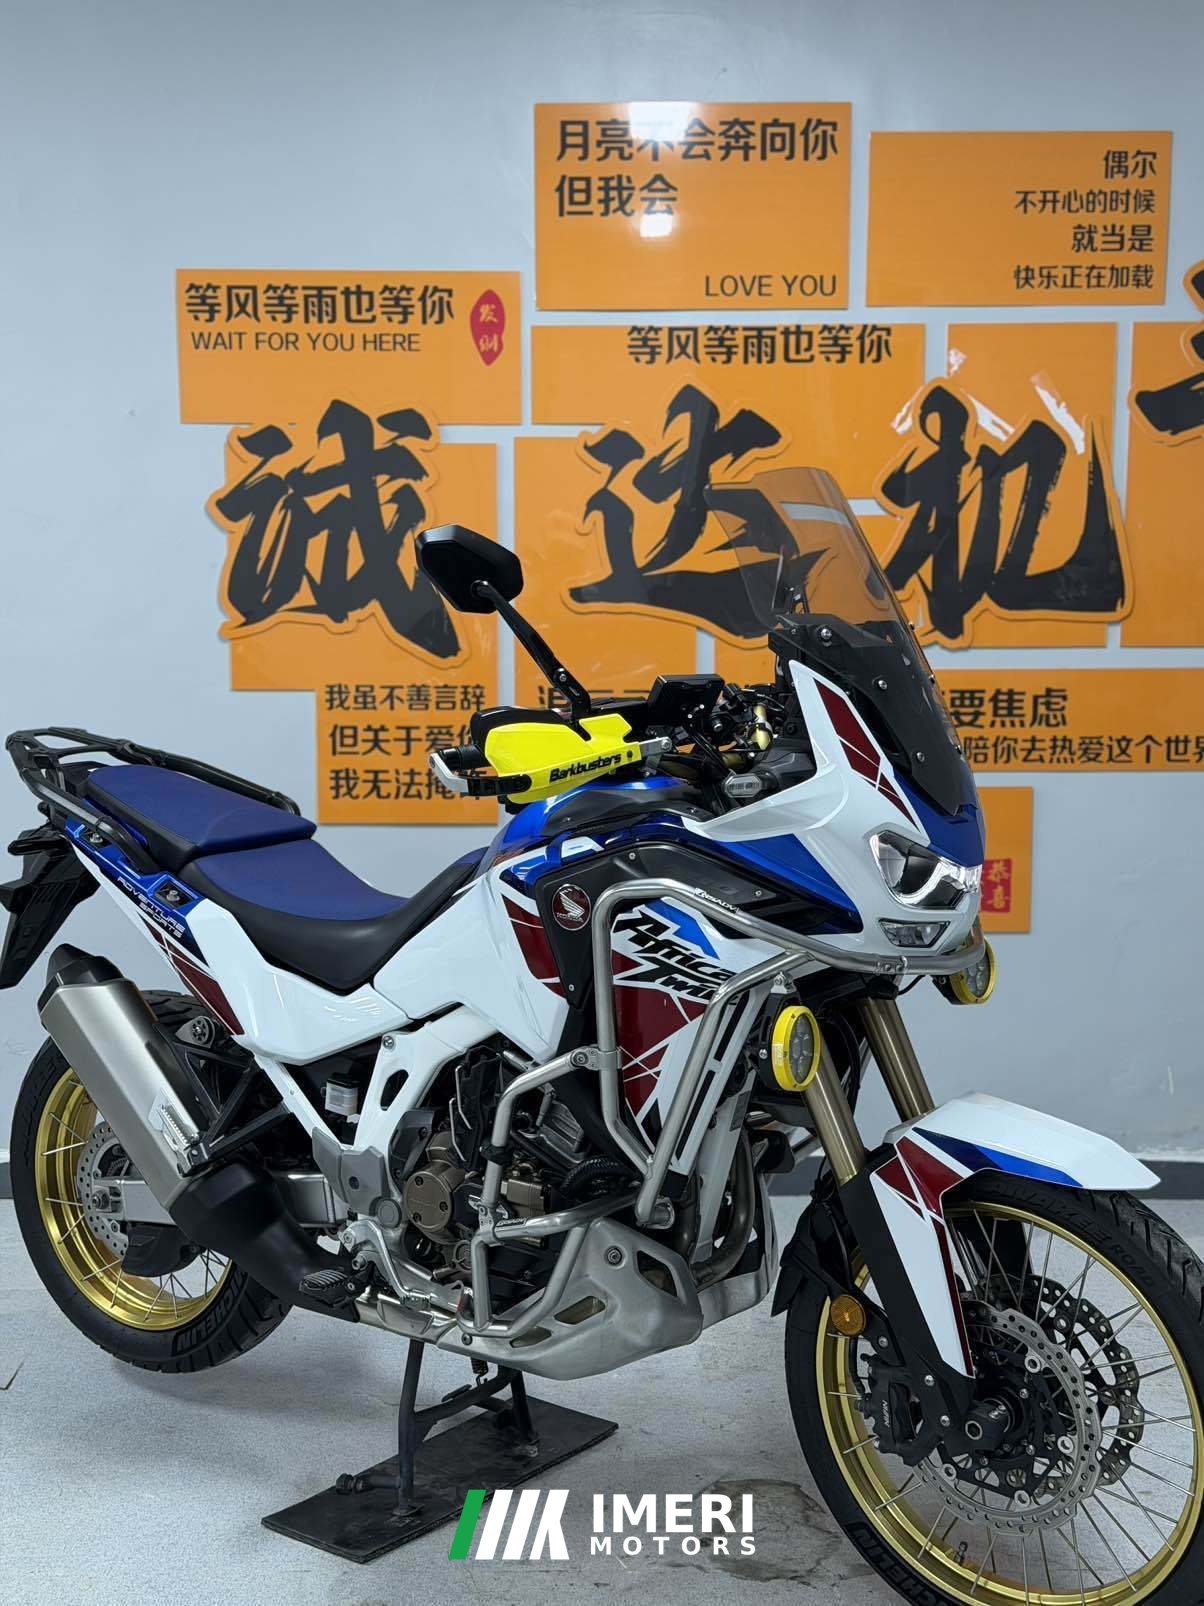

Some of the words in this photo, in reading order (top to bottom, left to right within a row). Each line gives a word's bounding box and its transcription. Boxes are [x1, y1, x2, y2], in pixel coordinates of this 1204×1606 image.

[556, 118, 838, 161] 月亮不会奔向你
[1104, 150, 1157, 179] 偶尔
[555, 173, 678, 217] 但我会
[1014, 189, 1155, 214] 不开心的时候
[1072, 224, 1154, 252] 就当是
[705, 275, 773, 296] LOVE
[781, 275, 837, 296] YOU
[1014, 264, 1154, 289] 快乐正在加载
[185, 283, 454, 325] 等风等雨也等你
[191, 331, 247, 350] WAIT
[254, 332, 300, 350] FOR
[306, 333, 355, 351] YOU
[362, 333, 421, 352] HERE
[632, 323, 892, 365] 等风等雨也等你
[325, 684, 486, 711] 我虽不善言辞
[941, 688, 1068, 729] 要焦虑
[550, 753, 622, 781] Barkbusters
[117, 876, 187, 932] ADVENTURE
[139, 902, 183, 938] SPORTS
